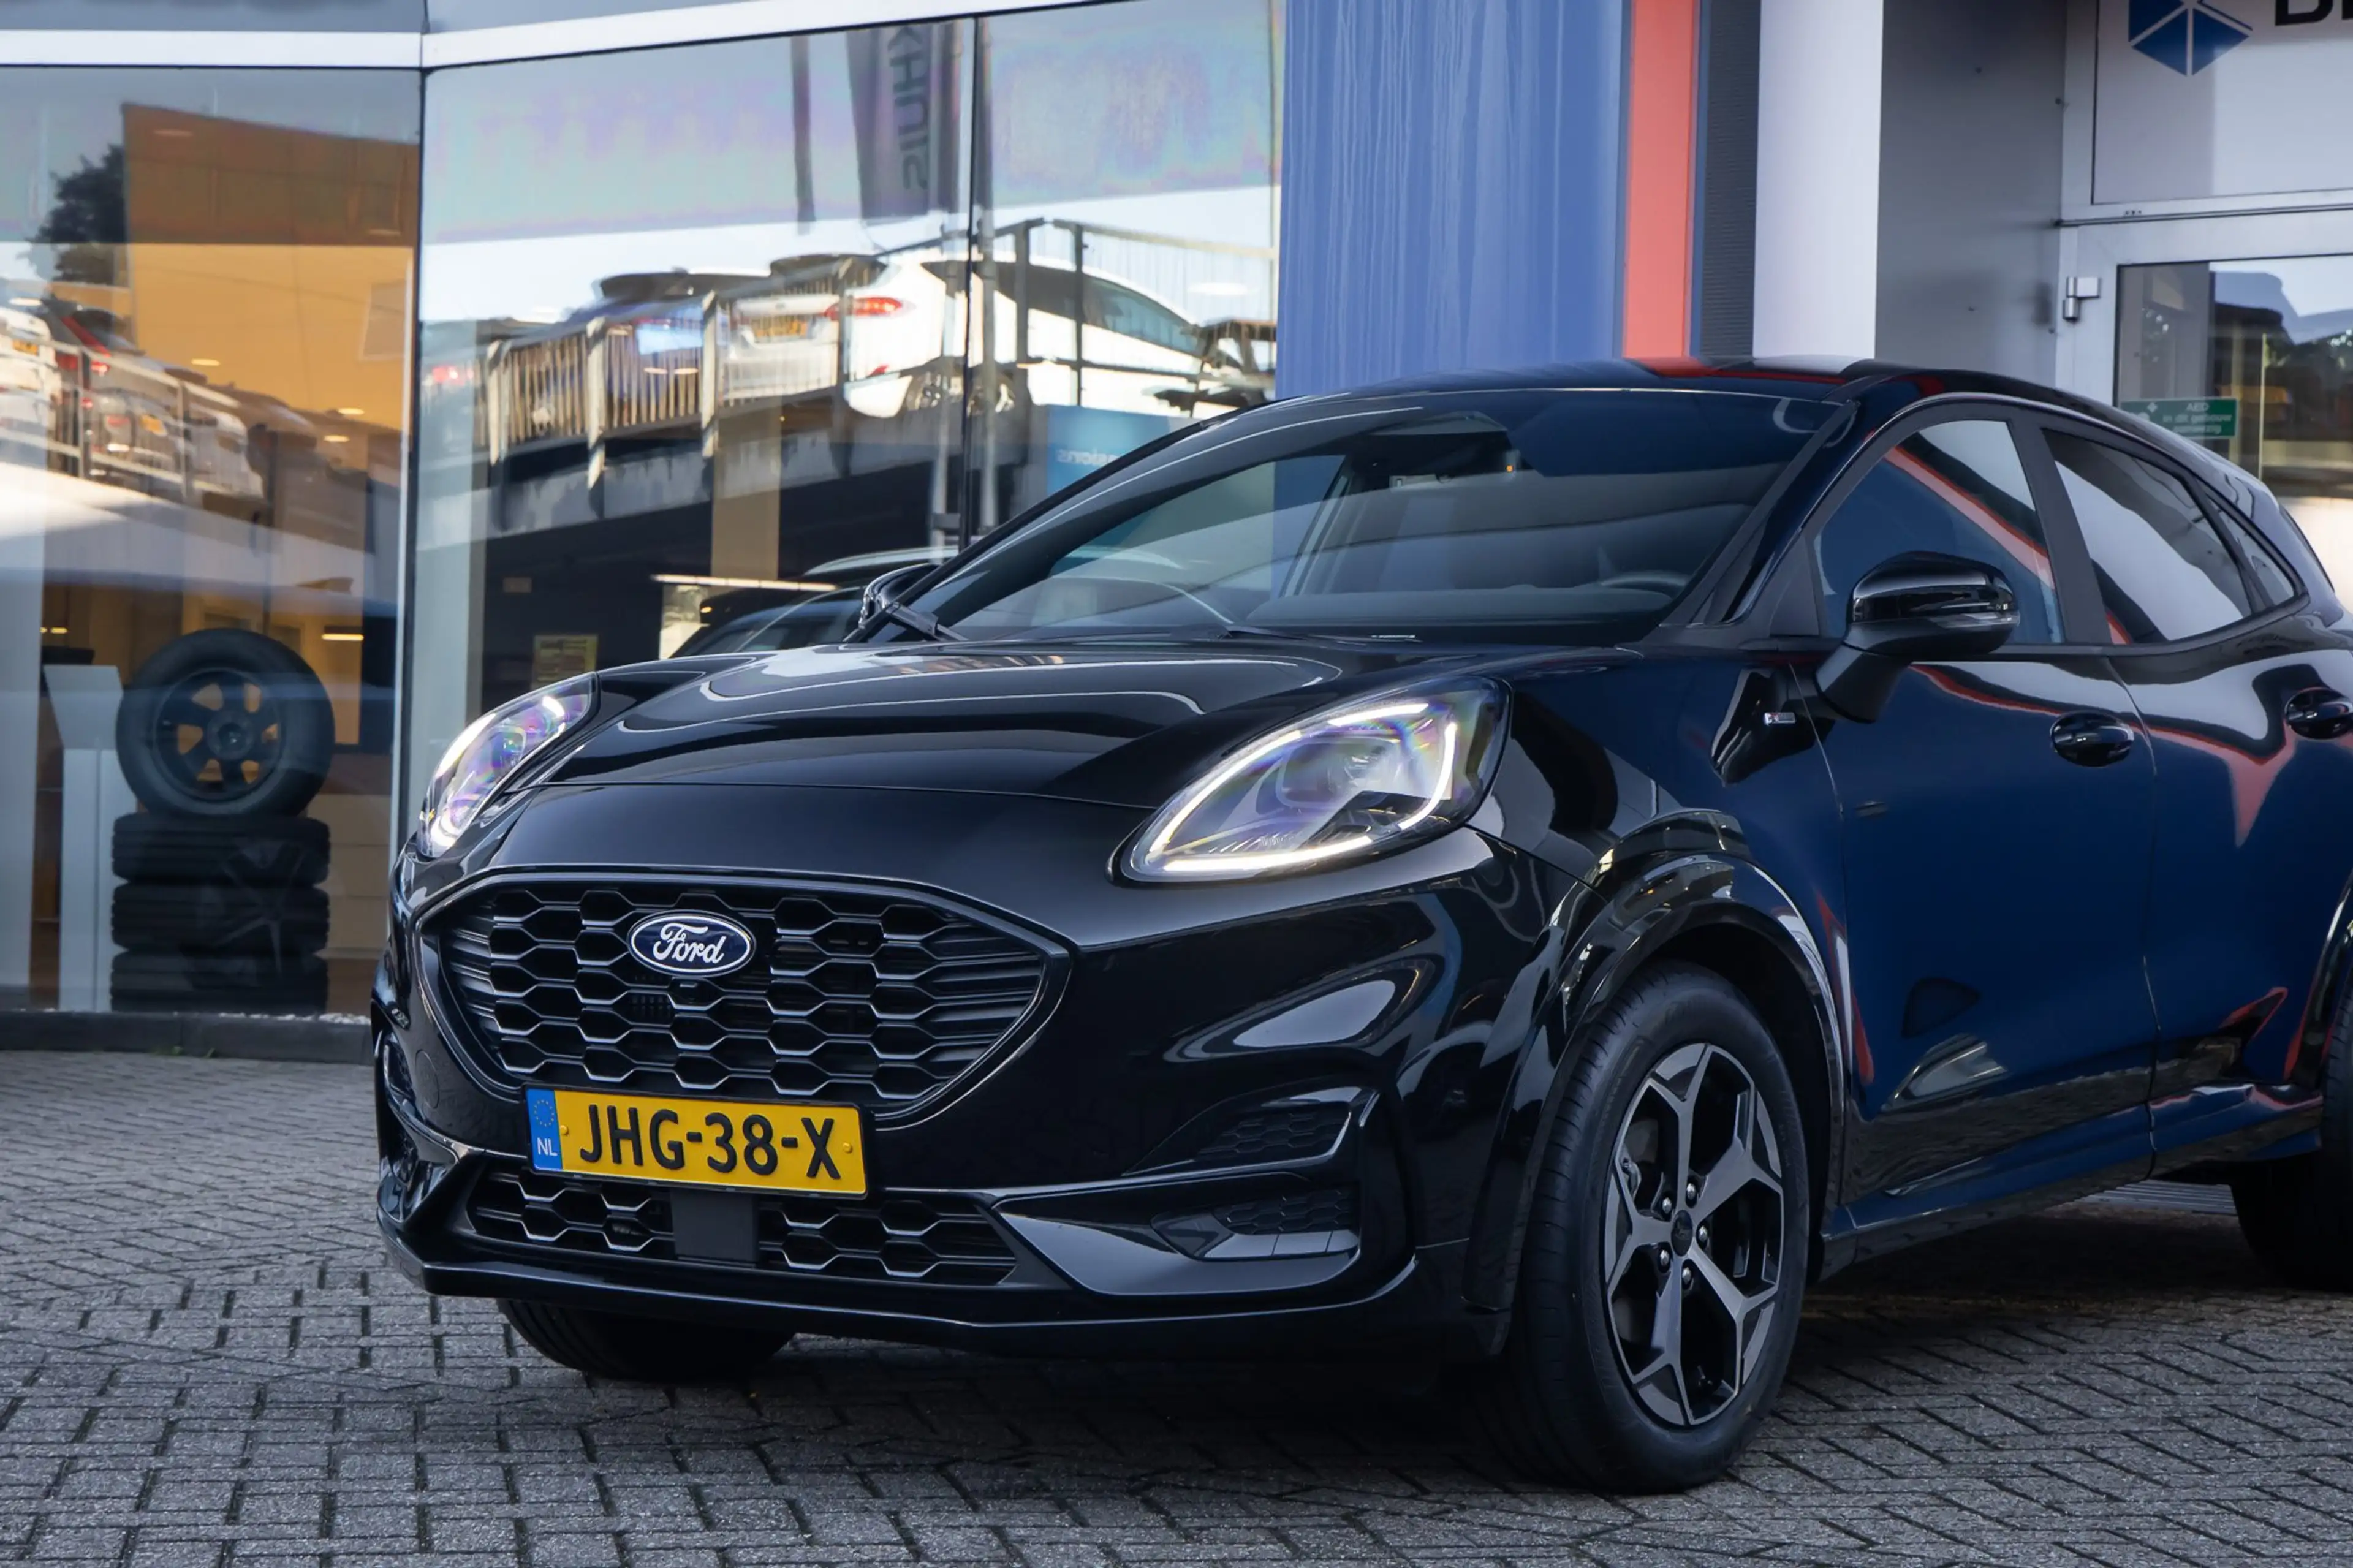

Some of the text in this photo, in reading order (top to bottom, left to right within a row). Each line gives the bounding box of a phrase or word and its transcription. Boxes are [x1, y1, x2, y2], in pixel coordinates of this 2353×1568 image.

[653, 923, 727, 964] Ford
[537, 1137, 558, 1156] NL
[580, 1104, 841, 1180] JHG-38-X
